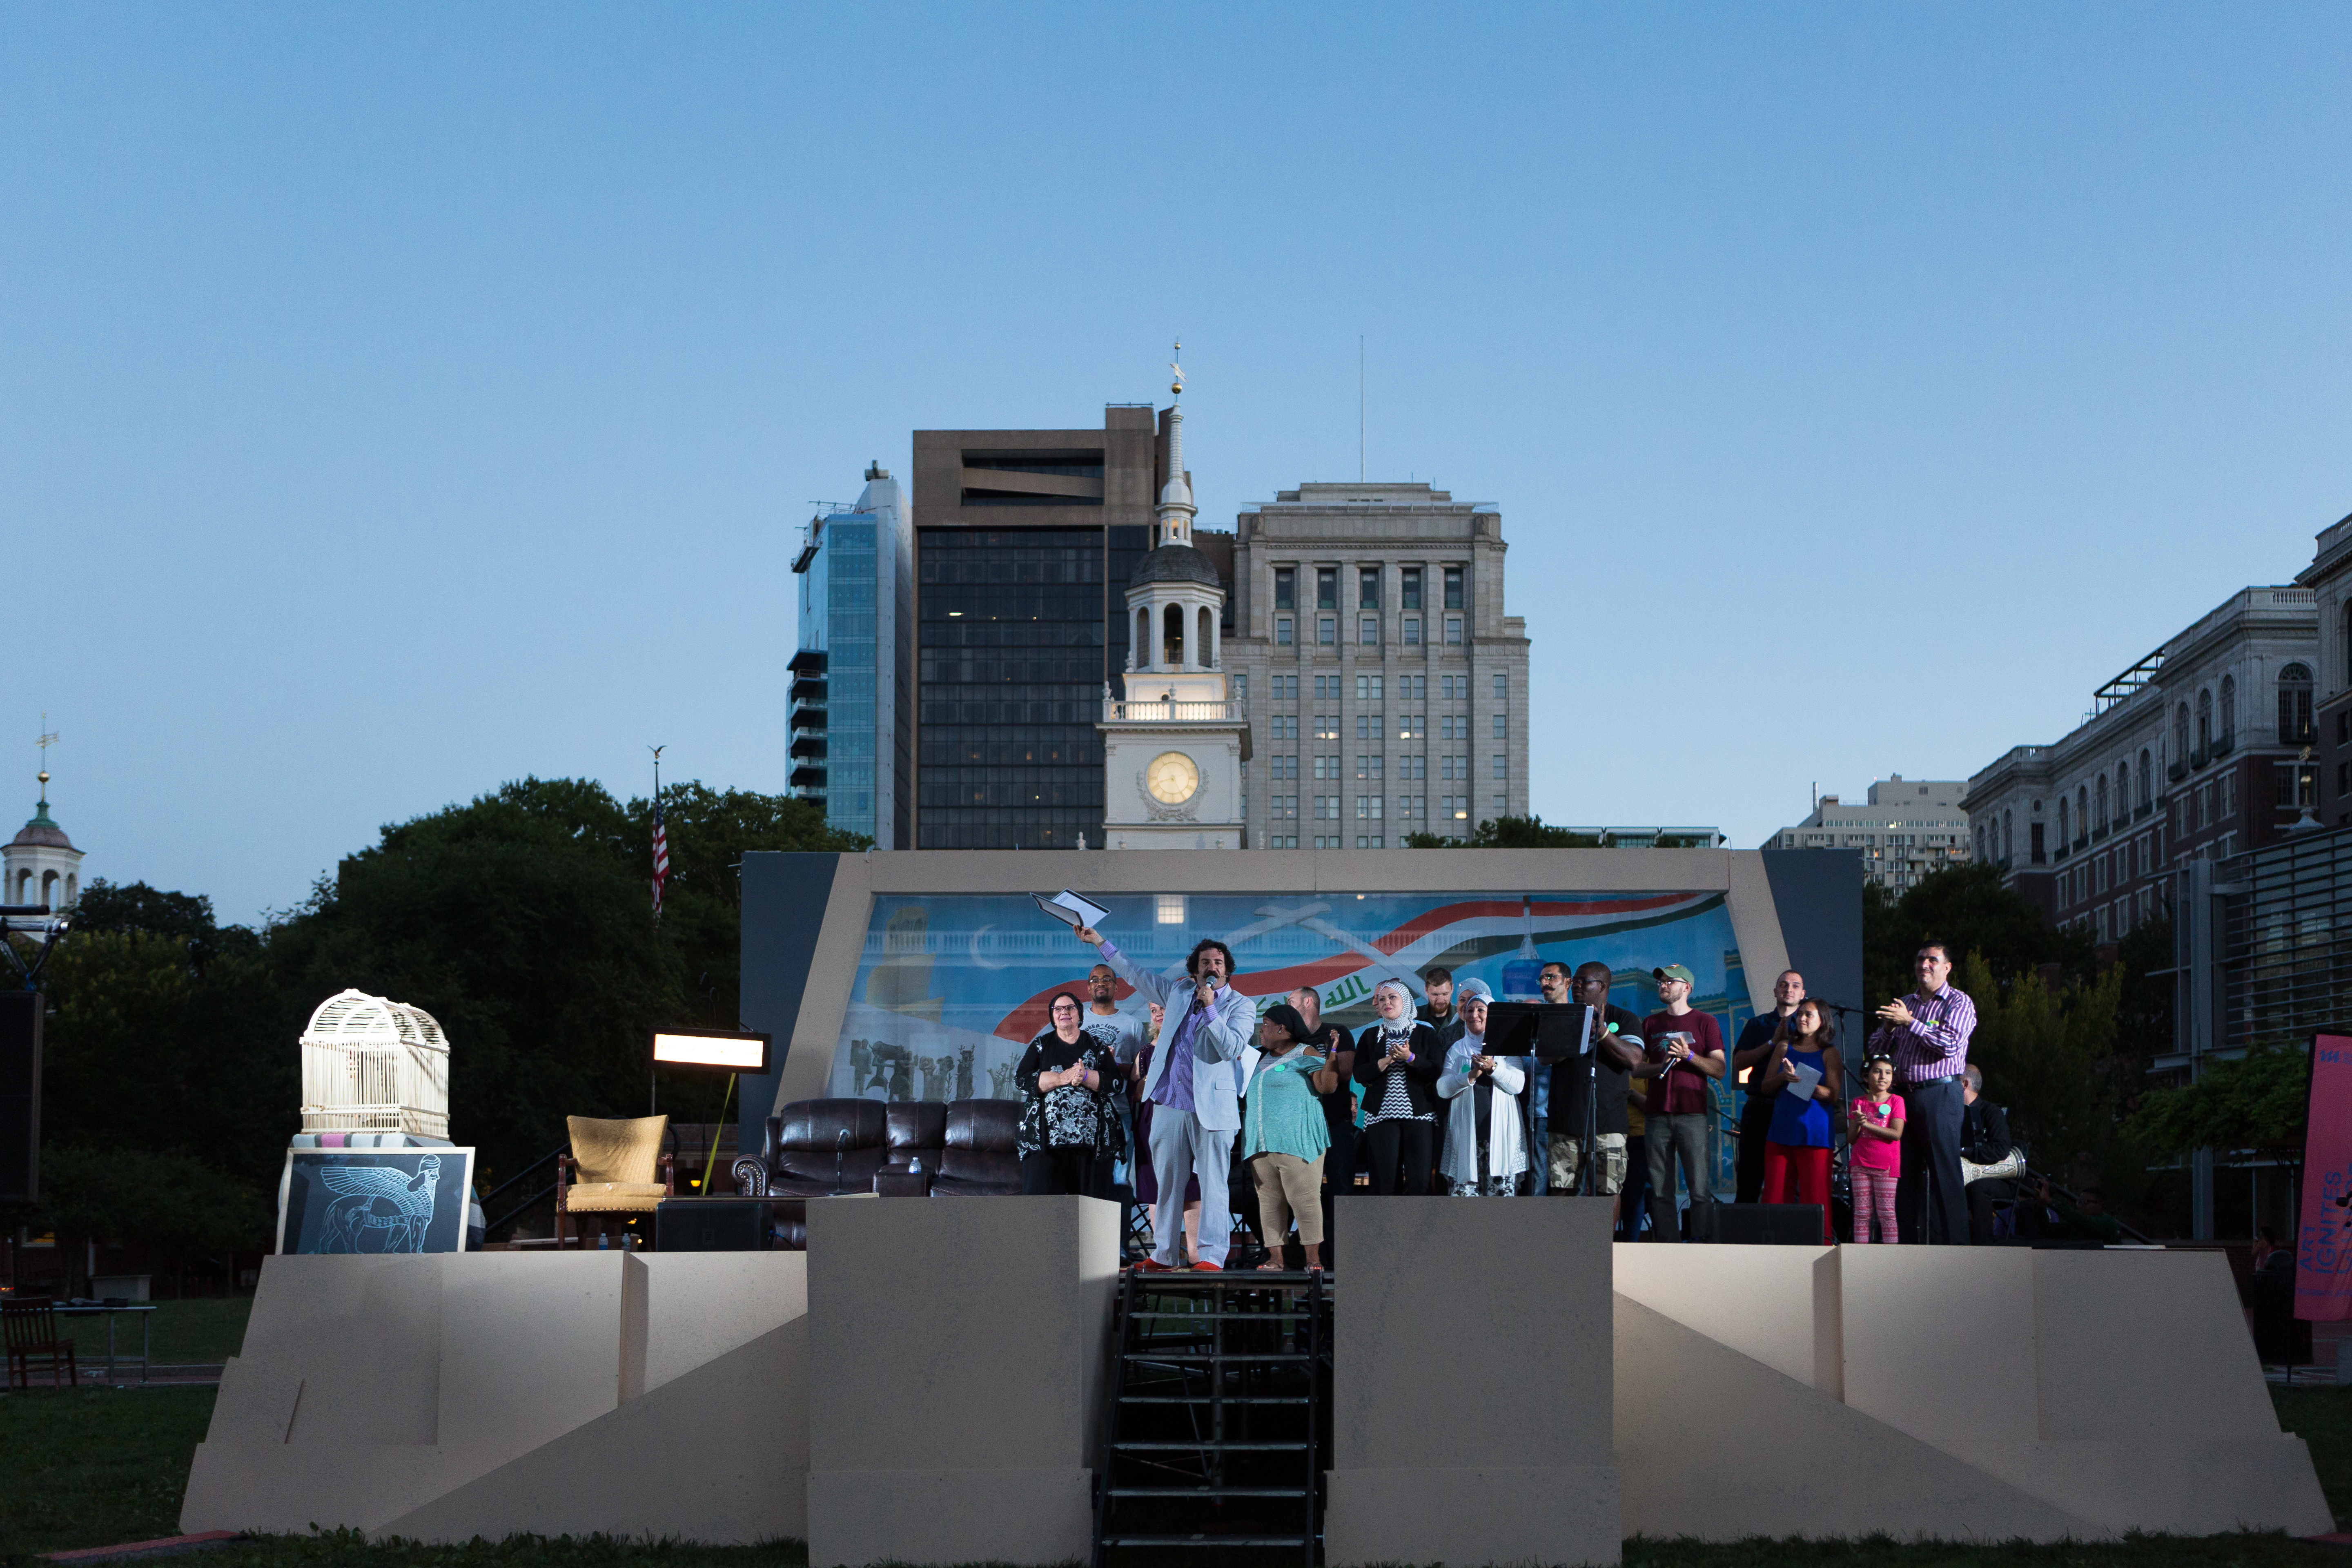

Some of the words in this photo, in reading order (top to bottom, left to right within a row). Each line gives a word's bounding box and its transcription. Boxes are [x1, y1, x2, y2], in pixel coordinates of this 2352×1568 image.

[1325, 974, 1372, 1009] الله
[1085, 1023, 1120, 1034] UBBA-LUBBA
[2315, 1171, 2341, 1274] IGNITES
[2298, 1222, 2316, 1272] ART
